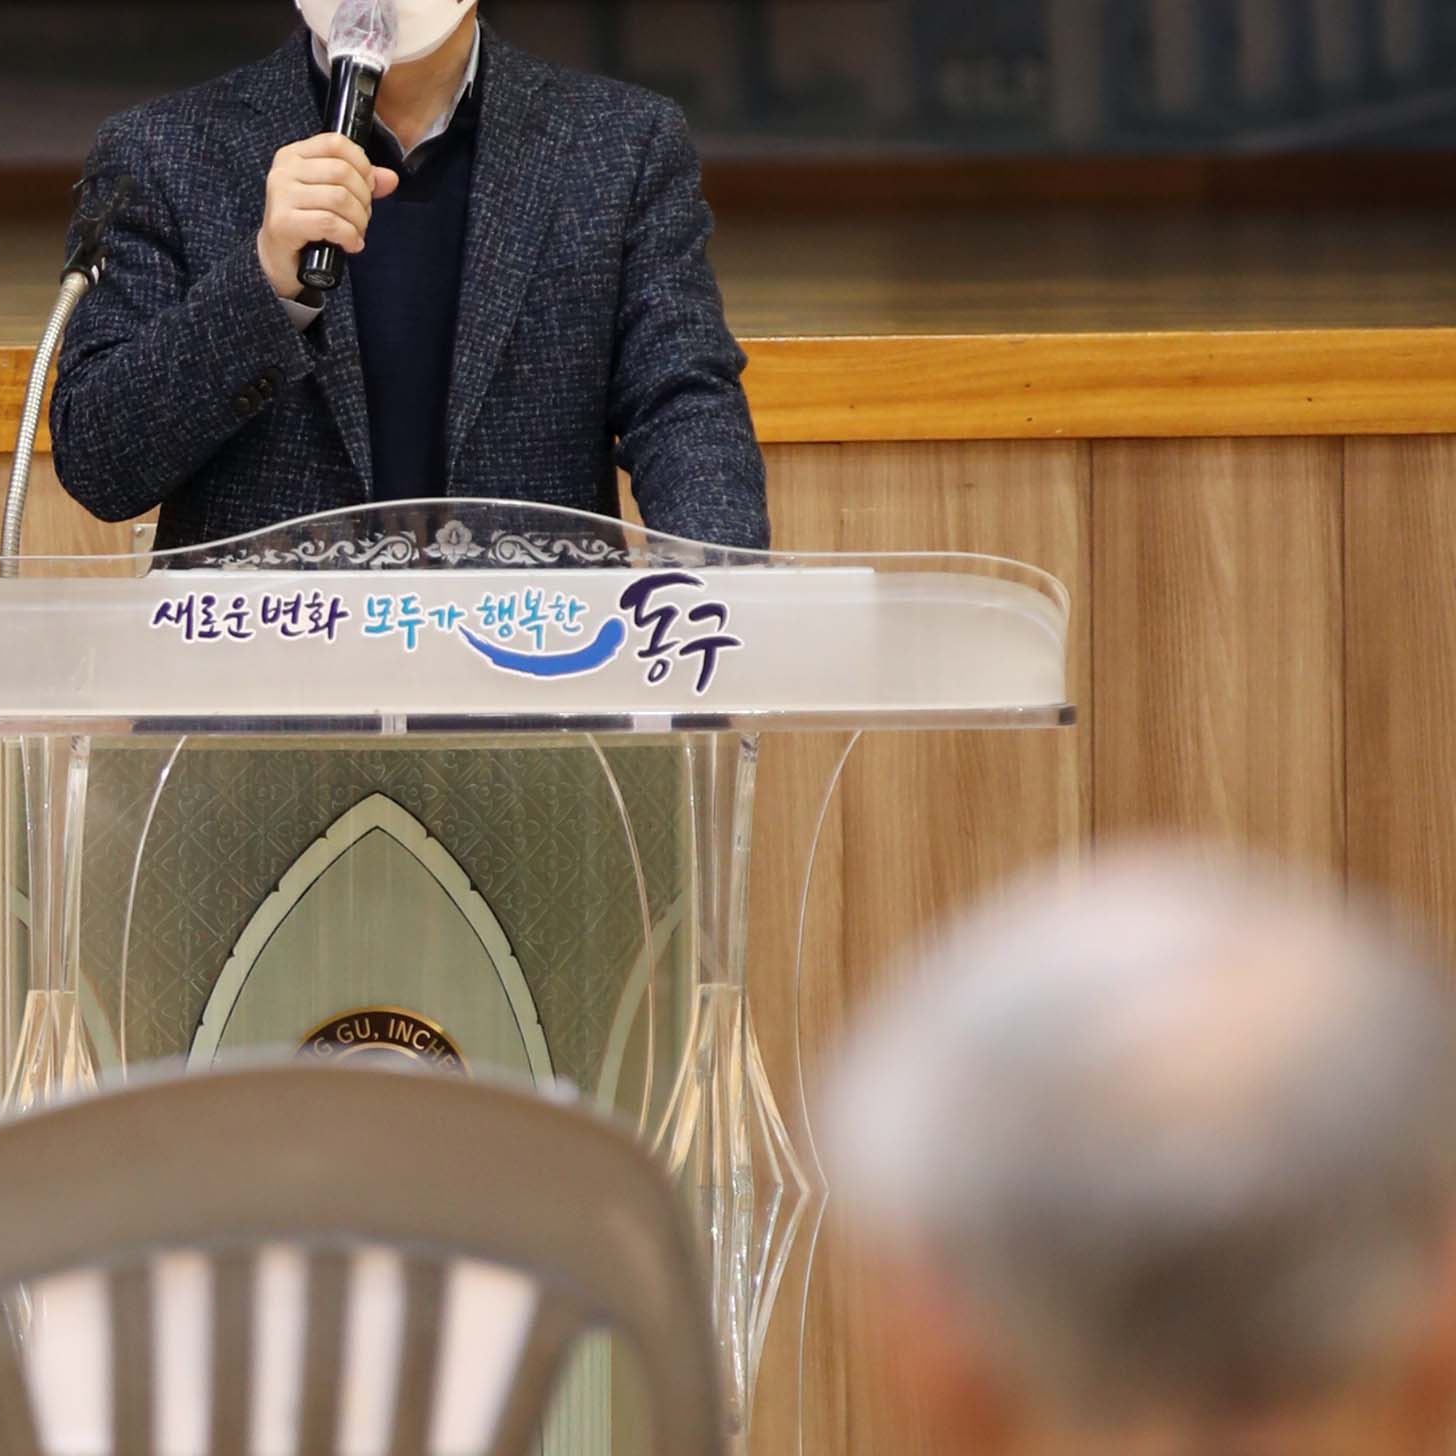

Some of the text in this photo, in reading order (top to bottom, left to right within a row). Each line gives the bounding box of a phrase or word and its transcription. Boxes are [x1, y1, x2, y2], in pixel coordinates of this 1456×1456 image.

[152, 572, 743, 693] 새로운 변화 모두가 행복한 동구
[336, 1018, 380, 1044] GU,
